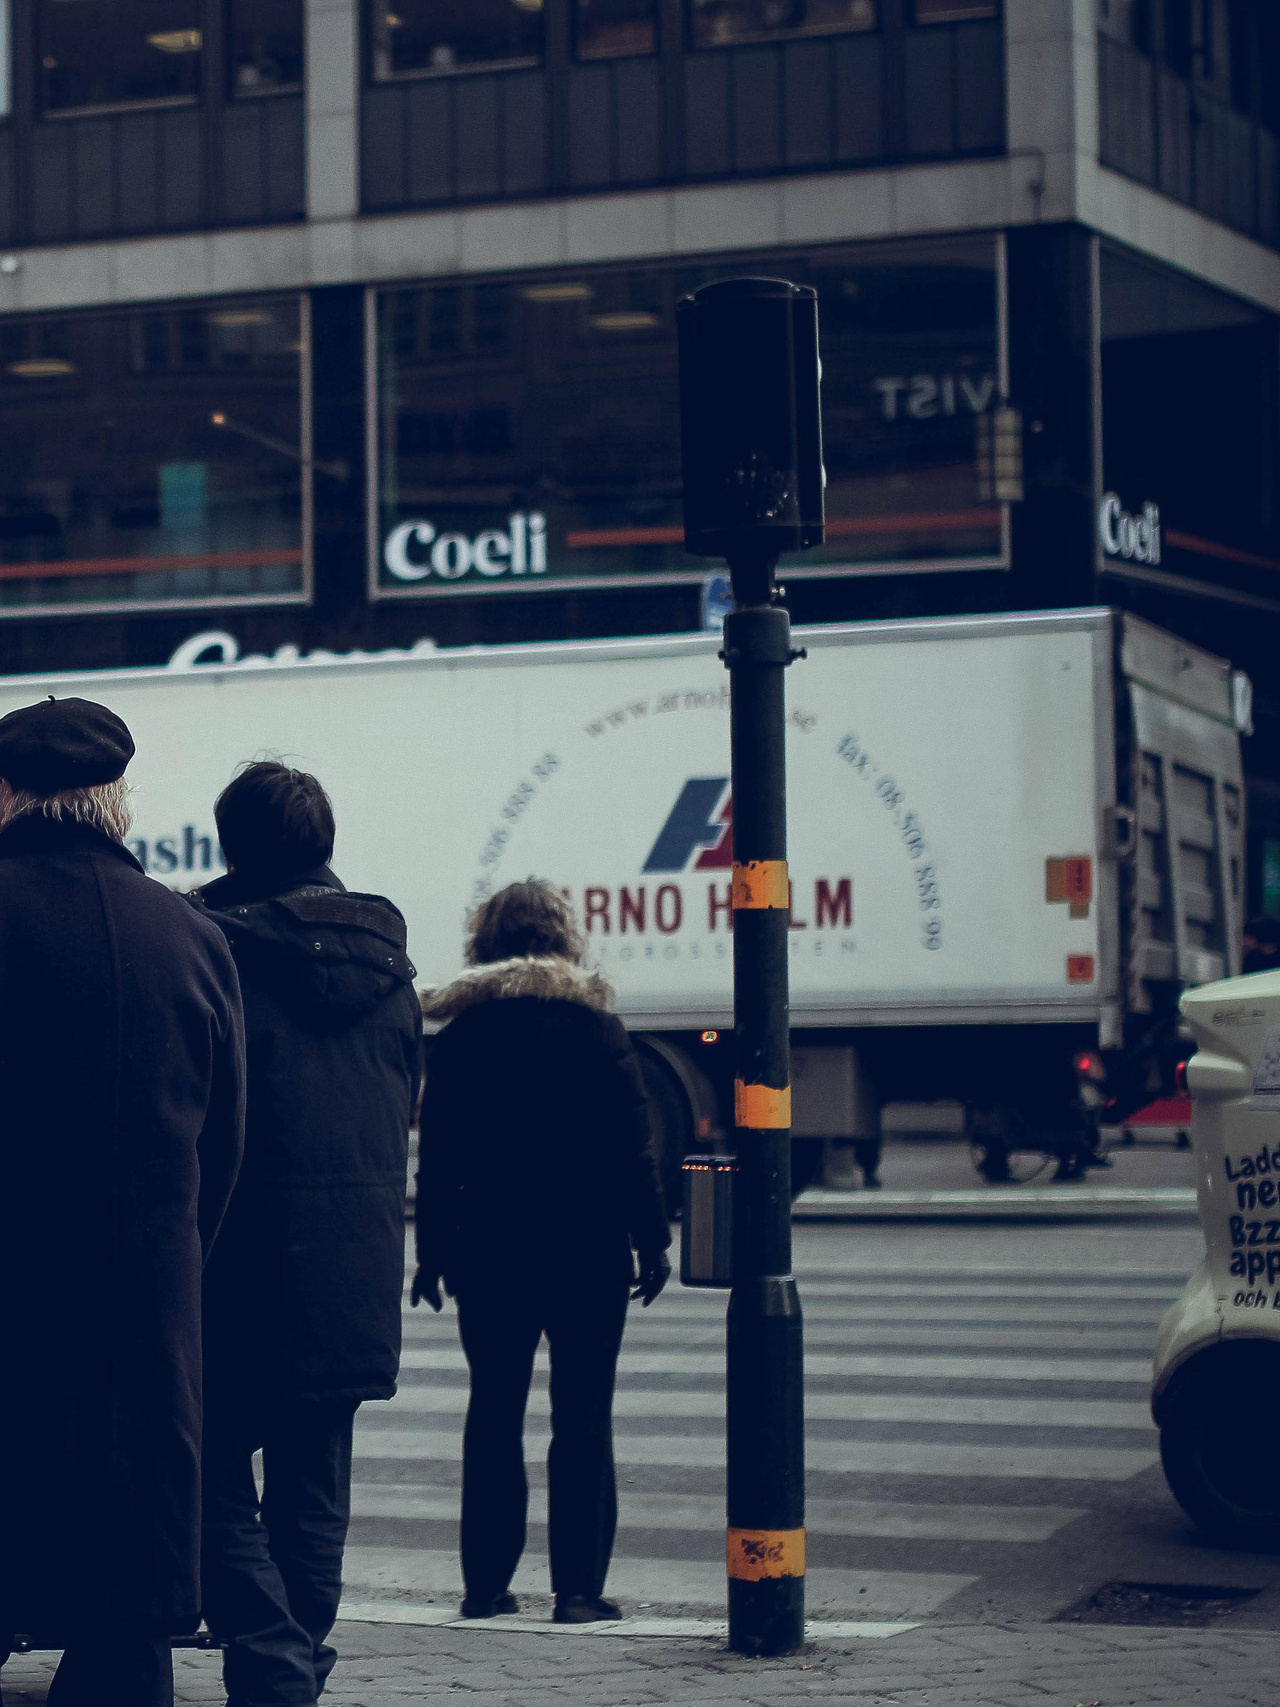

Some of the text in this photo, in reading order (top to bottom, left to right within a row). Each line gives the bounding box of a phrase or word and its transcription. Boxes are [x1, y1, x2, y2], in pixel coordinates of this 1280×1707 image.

[384, 511, 548, 581] Coeli
[1099, 491, 1161, 565] Coeli
[561, 877, 854, 937] RNO HLM
[1233, 1288, 1268, 1309] och
